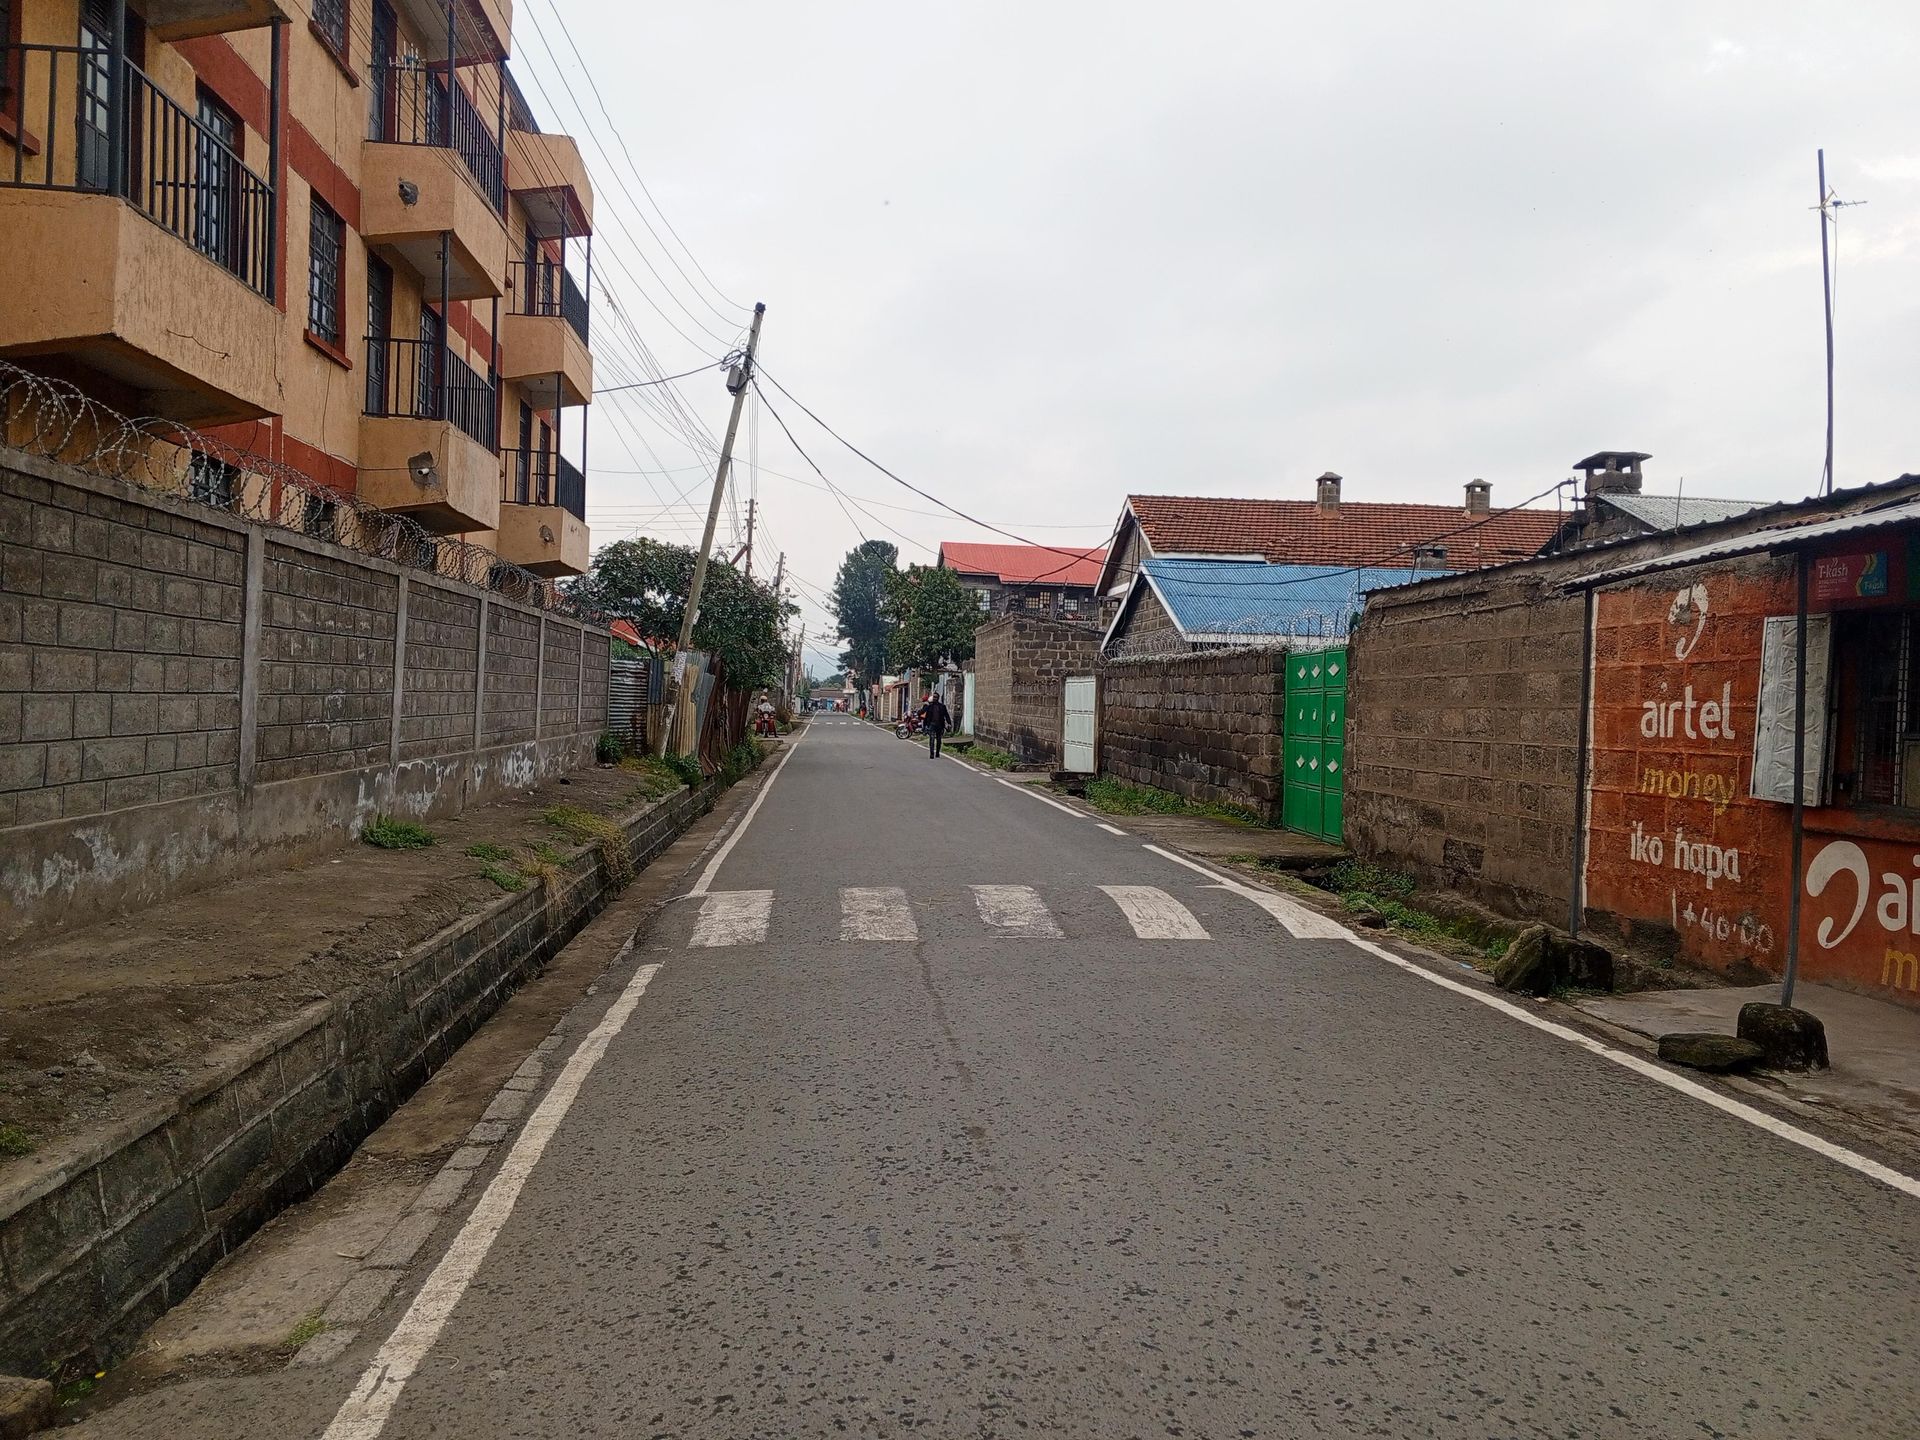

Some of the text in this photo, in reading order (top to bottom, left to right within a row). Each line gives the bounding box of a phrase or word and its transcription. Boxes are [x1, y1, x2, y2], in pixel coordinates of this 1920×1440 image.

[1818, 564, 1848, 578] T-kash
[1640, 680, 1736, 740] airtel
[1641, 767, 1736, 816] money
[1630, 820, 1741, 891] iko hapa
